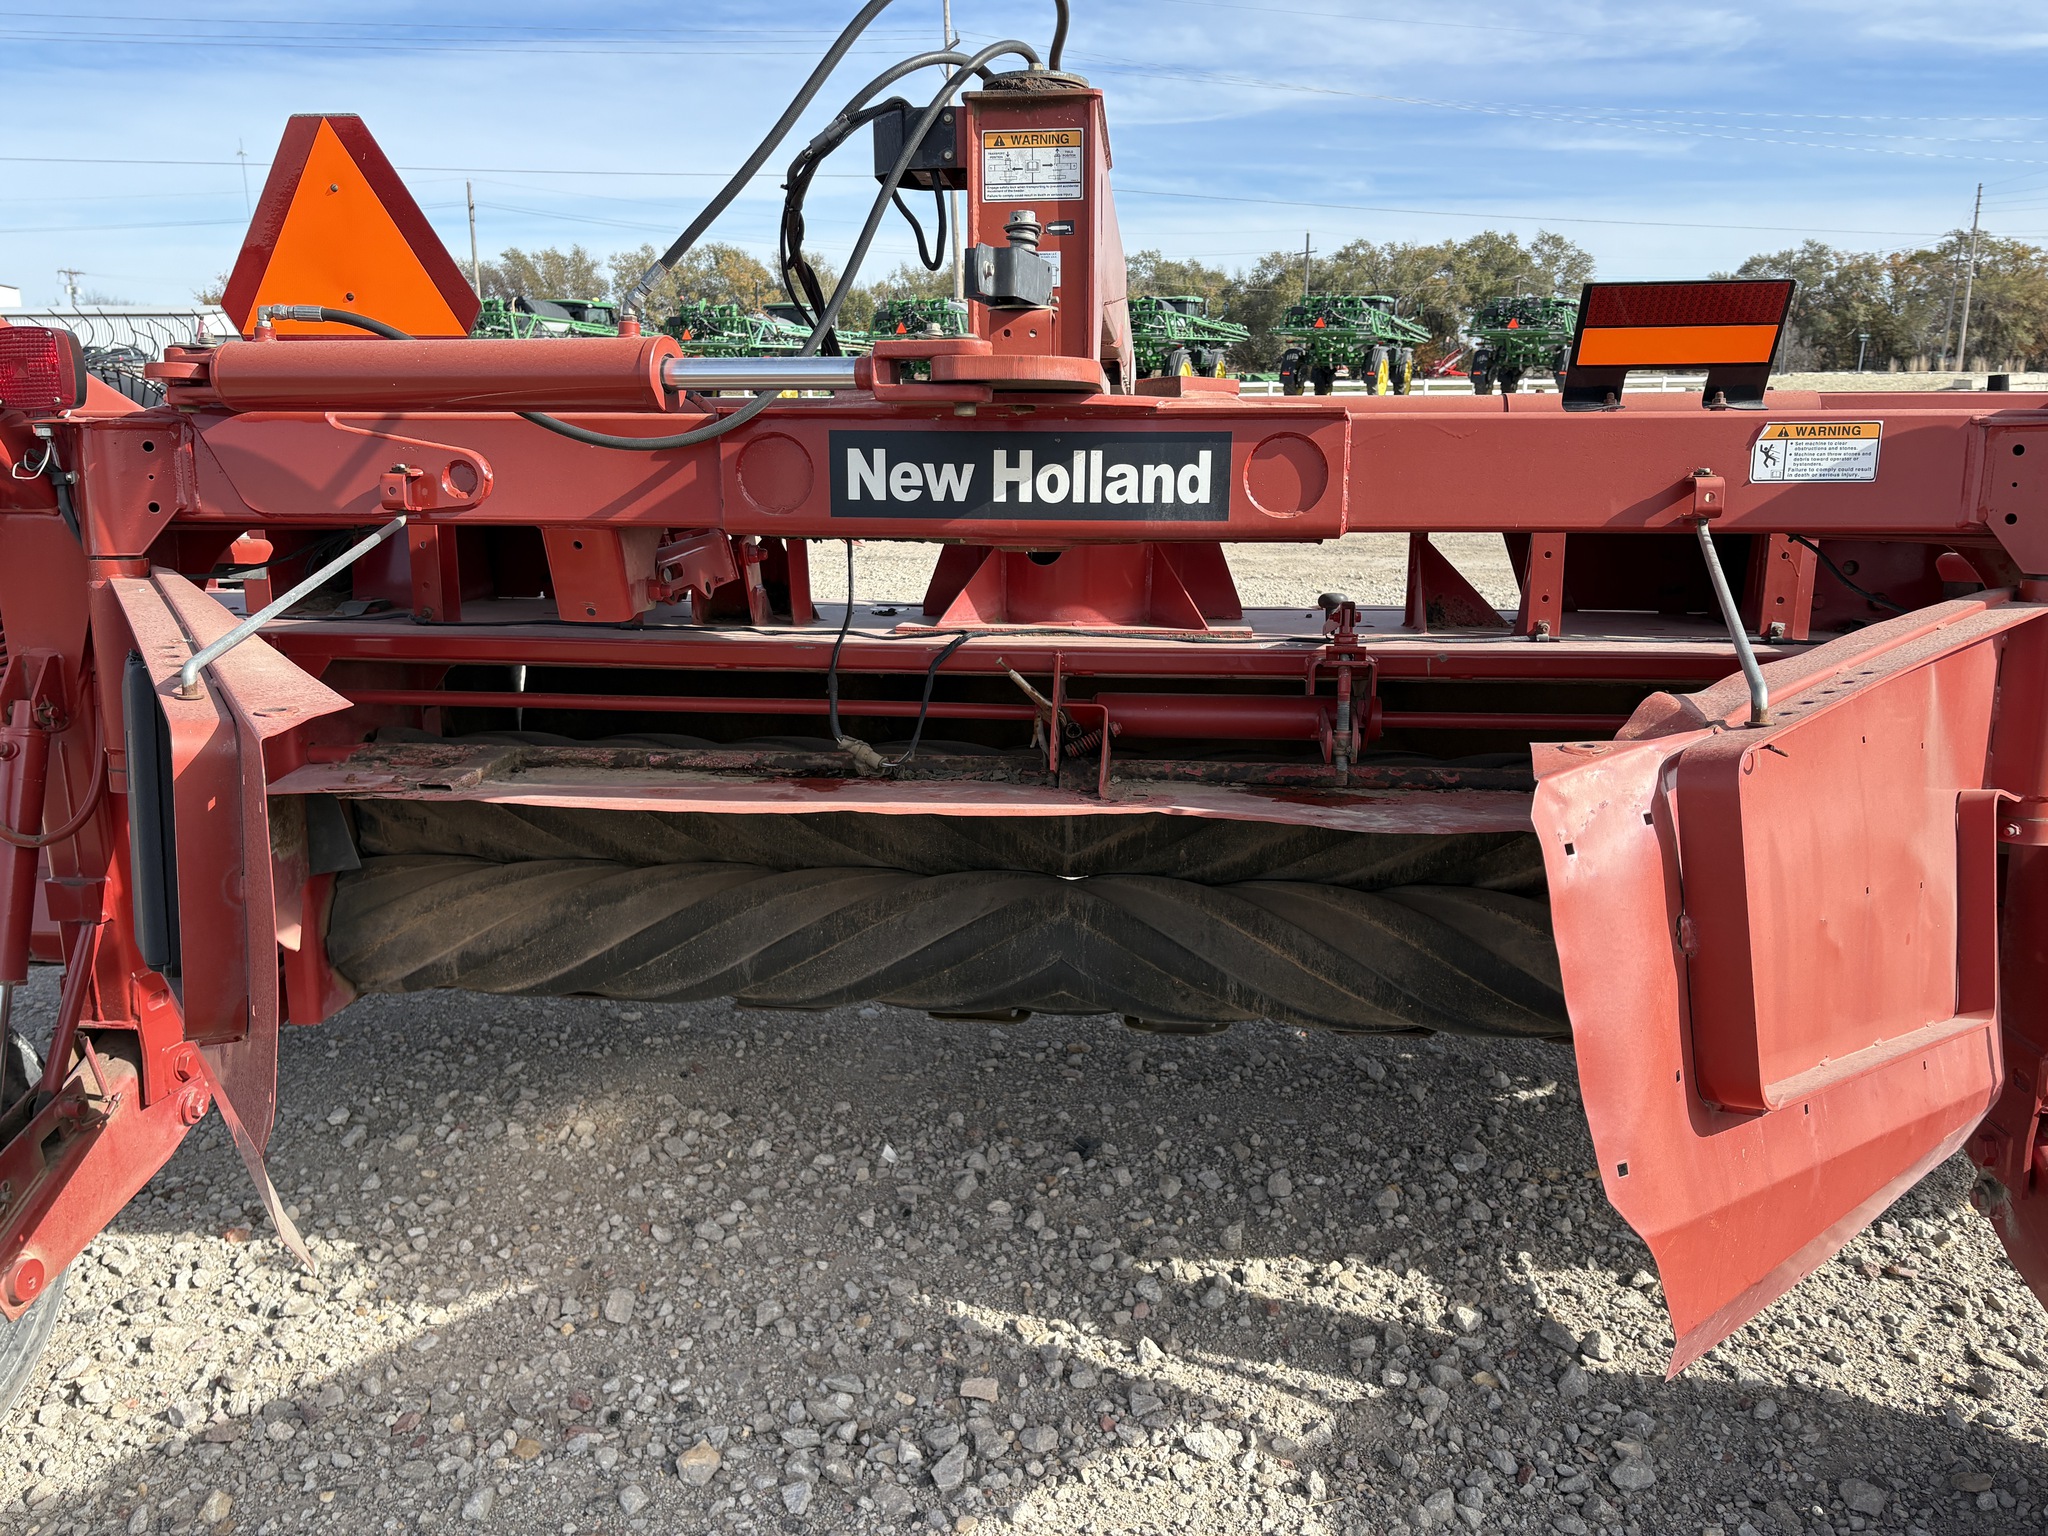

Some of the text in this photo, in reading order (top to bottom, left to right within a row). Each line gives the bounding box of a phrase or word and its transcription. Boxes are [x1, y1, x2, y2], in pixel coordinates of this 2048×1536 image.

[1010, 134, 1070, 145] WARNING
[1796, 425, 1862, 437] WARNING
[847, 448, 1212, 504] New Holland
